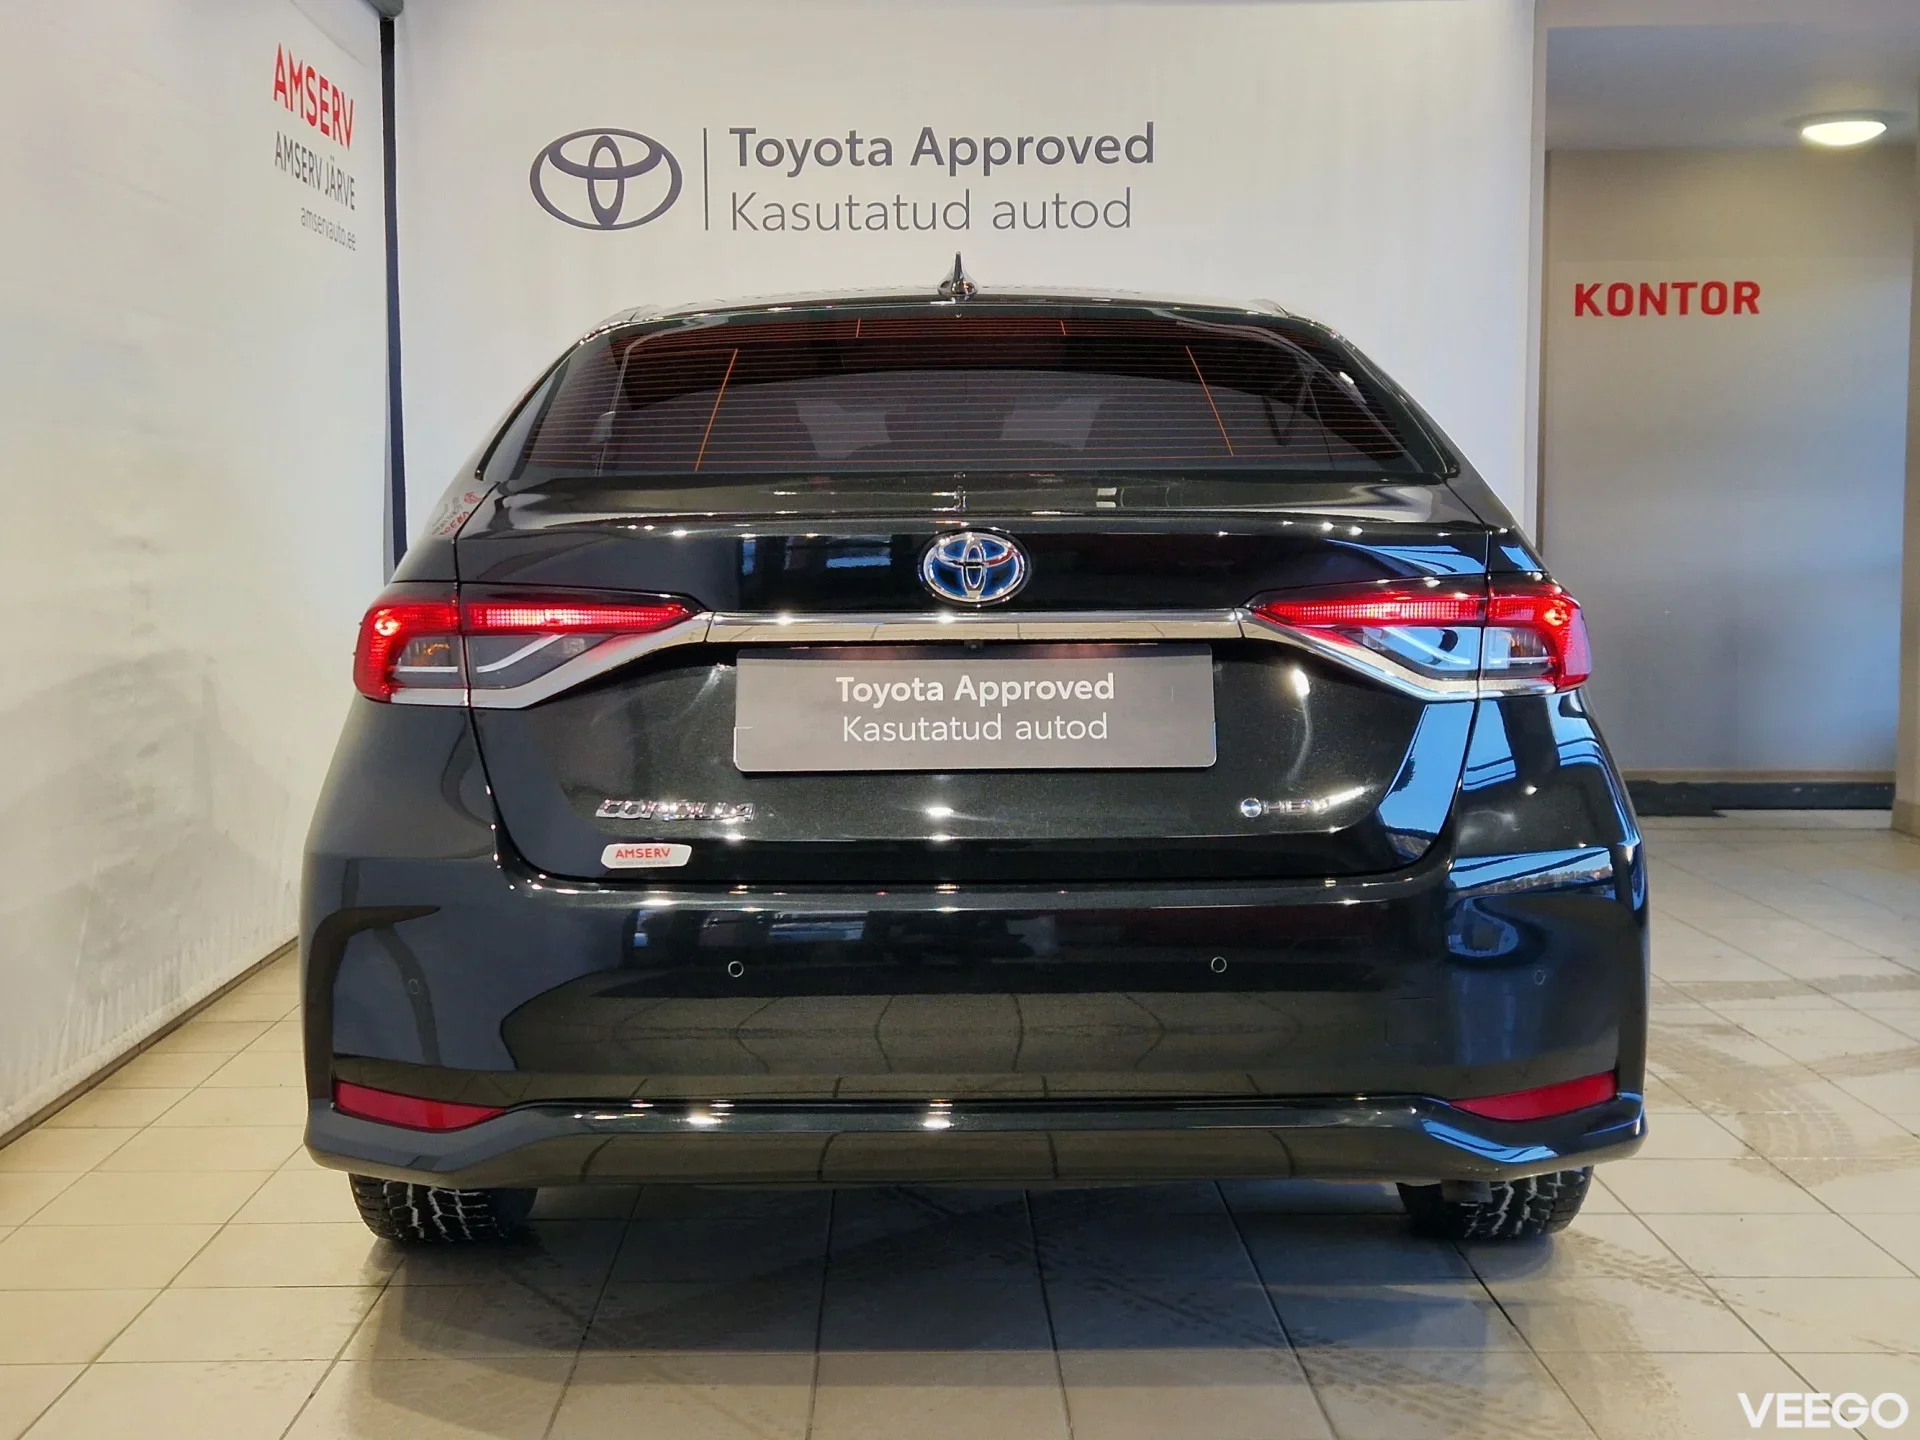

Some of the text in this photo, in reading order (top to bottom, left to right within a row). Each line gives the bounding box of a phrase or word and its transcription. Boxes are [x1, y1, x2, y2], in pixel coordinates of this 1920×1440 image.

[274, 42, 354, 150] AMSERV
[274, 130, 356, 211] AMSERV JÄRVE
[729, 121, 1155, 177] Toyota Approved
[300, 205, 357, 252] amservauto.ee
[731, 186, 1132, 232] Kasutatud autod
[1574, 281, 1761, 317] KONTOR
[836, 672, 1116, 709] Toyota Approved
[843, 712, 1109, 743] Kasutatud autod
[614, 847, 672, 859] AMSERV
